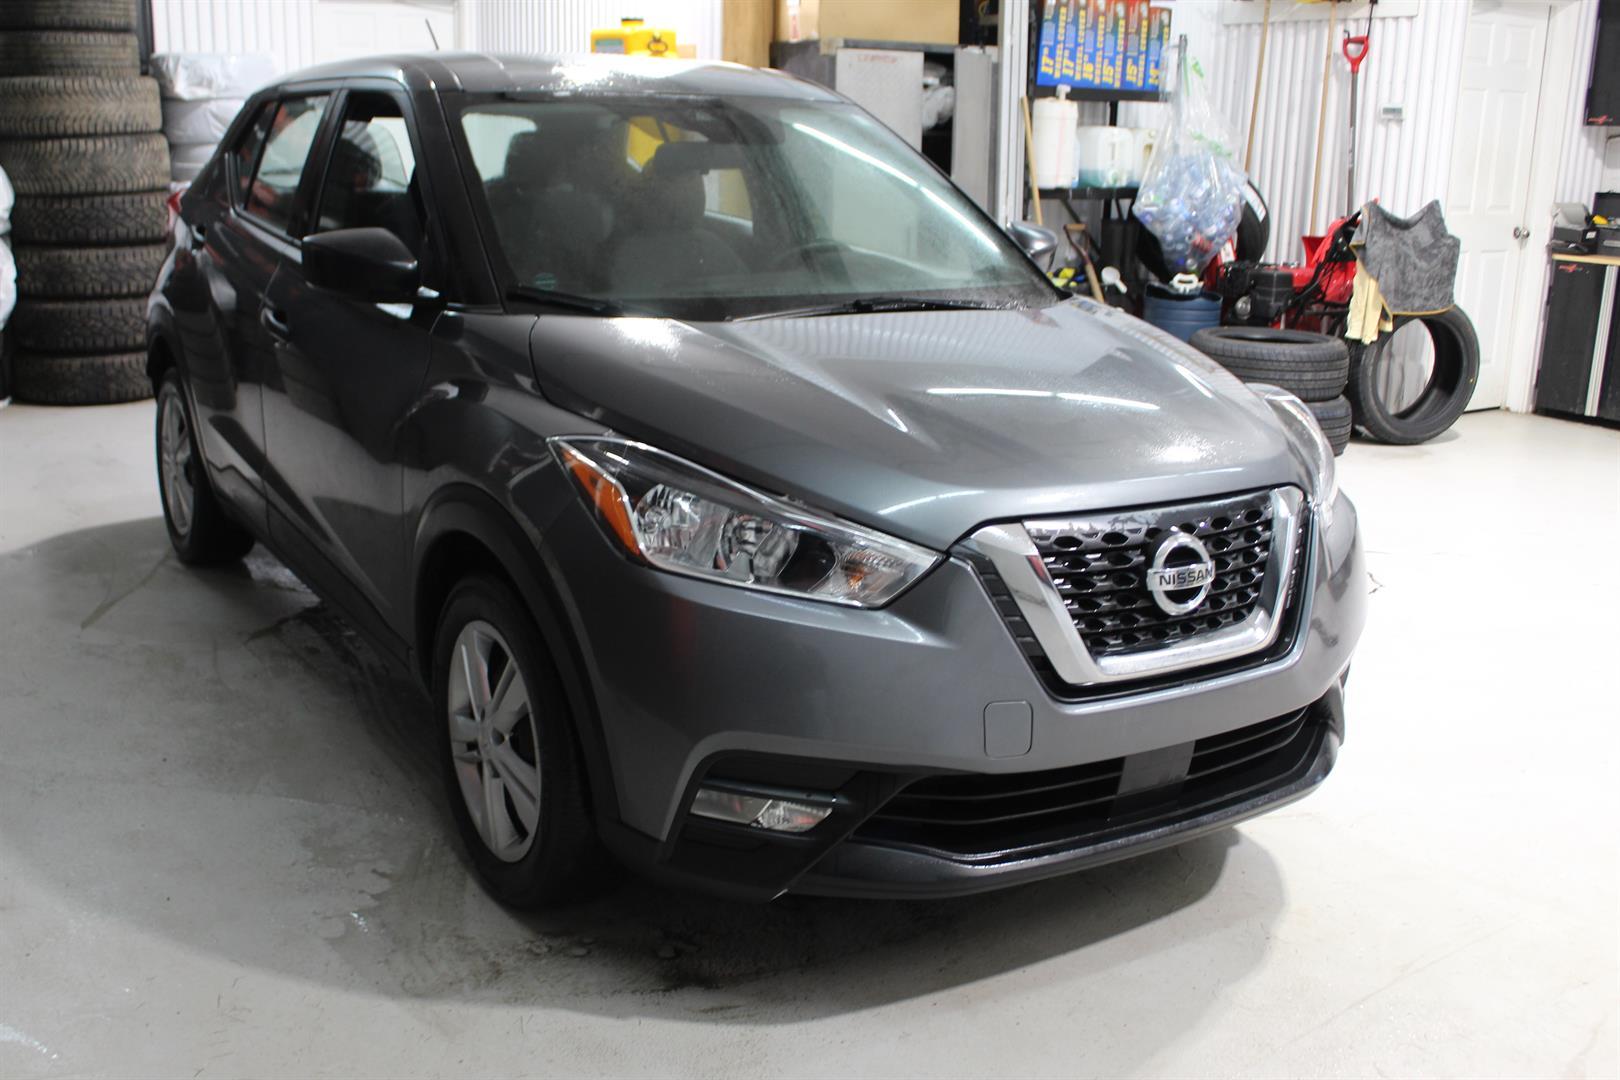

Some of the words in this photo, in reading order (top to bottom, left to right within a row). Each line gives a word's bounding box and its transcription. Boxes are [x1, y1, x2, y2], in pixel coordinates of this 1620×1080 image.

[1041, 47, 1054, 74] 17"
[1062, 49, 1074, 76] 17"
[1159, 568, 1212, 586] NISSAN
